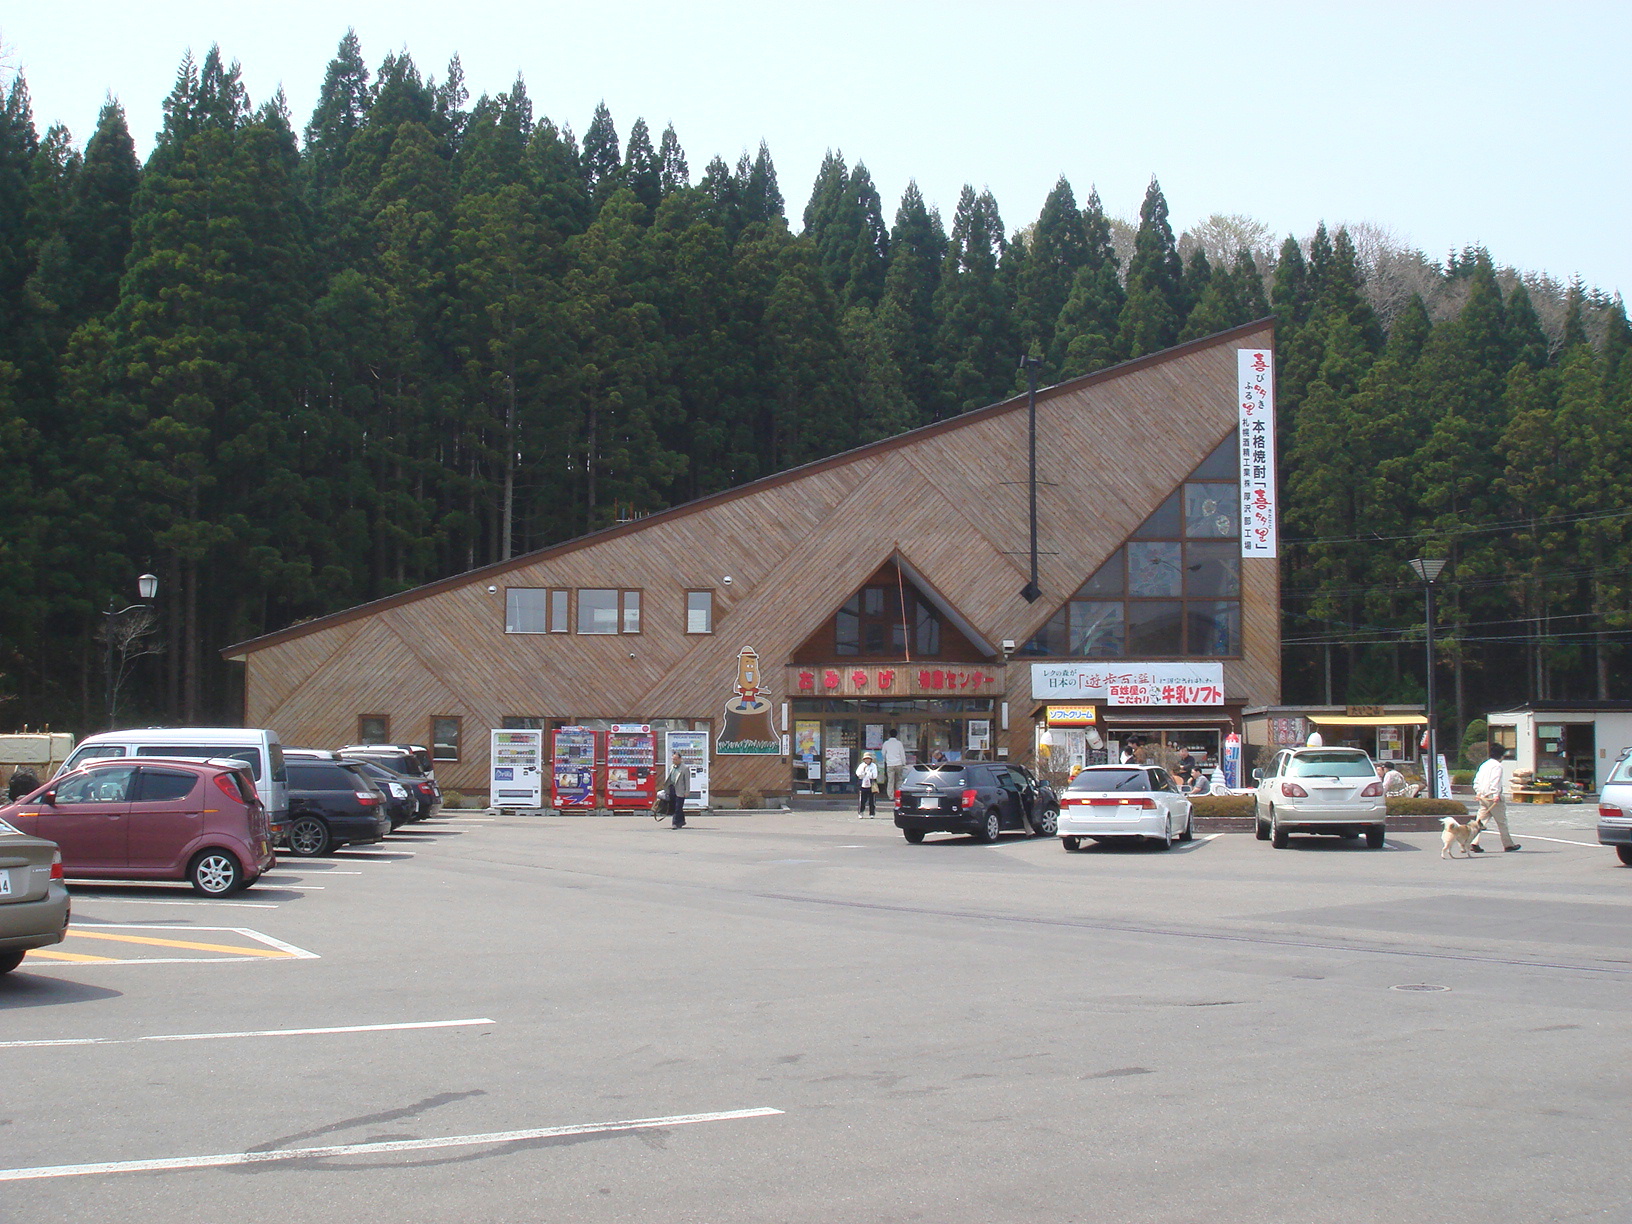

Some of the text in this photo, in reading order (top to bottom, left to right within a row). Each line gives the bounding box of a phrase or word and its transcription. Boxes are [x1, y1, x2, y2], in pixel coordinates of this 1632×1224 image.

[798, 669, 995, 690] おみやげ 物産センター
[1049, 677, 1077, 688] 日本の
[1109, 684, 1147, 696] 百姓屋の
[1161, 684, 1222, 704] 牛乳ソフト
[1117, 695, 1149, 704] こだわり
[1050, 710, 1093, 719] ソフトクリーム
